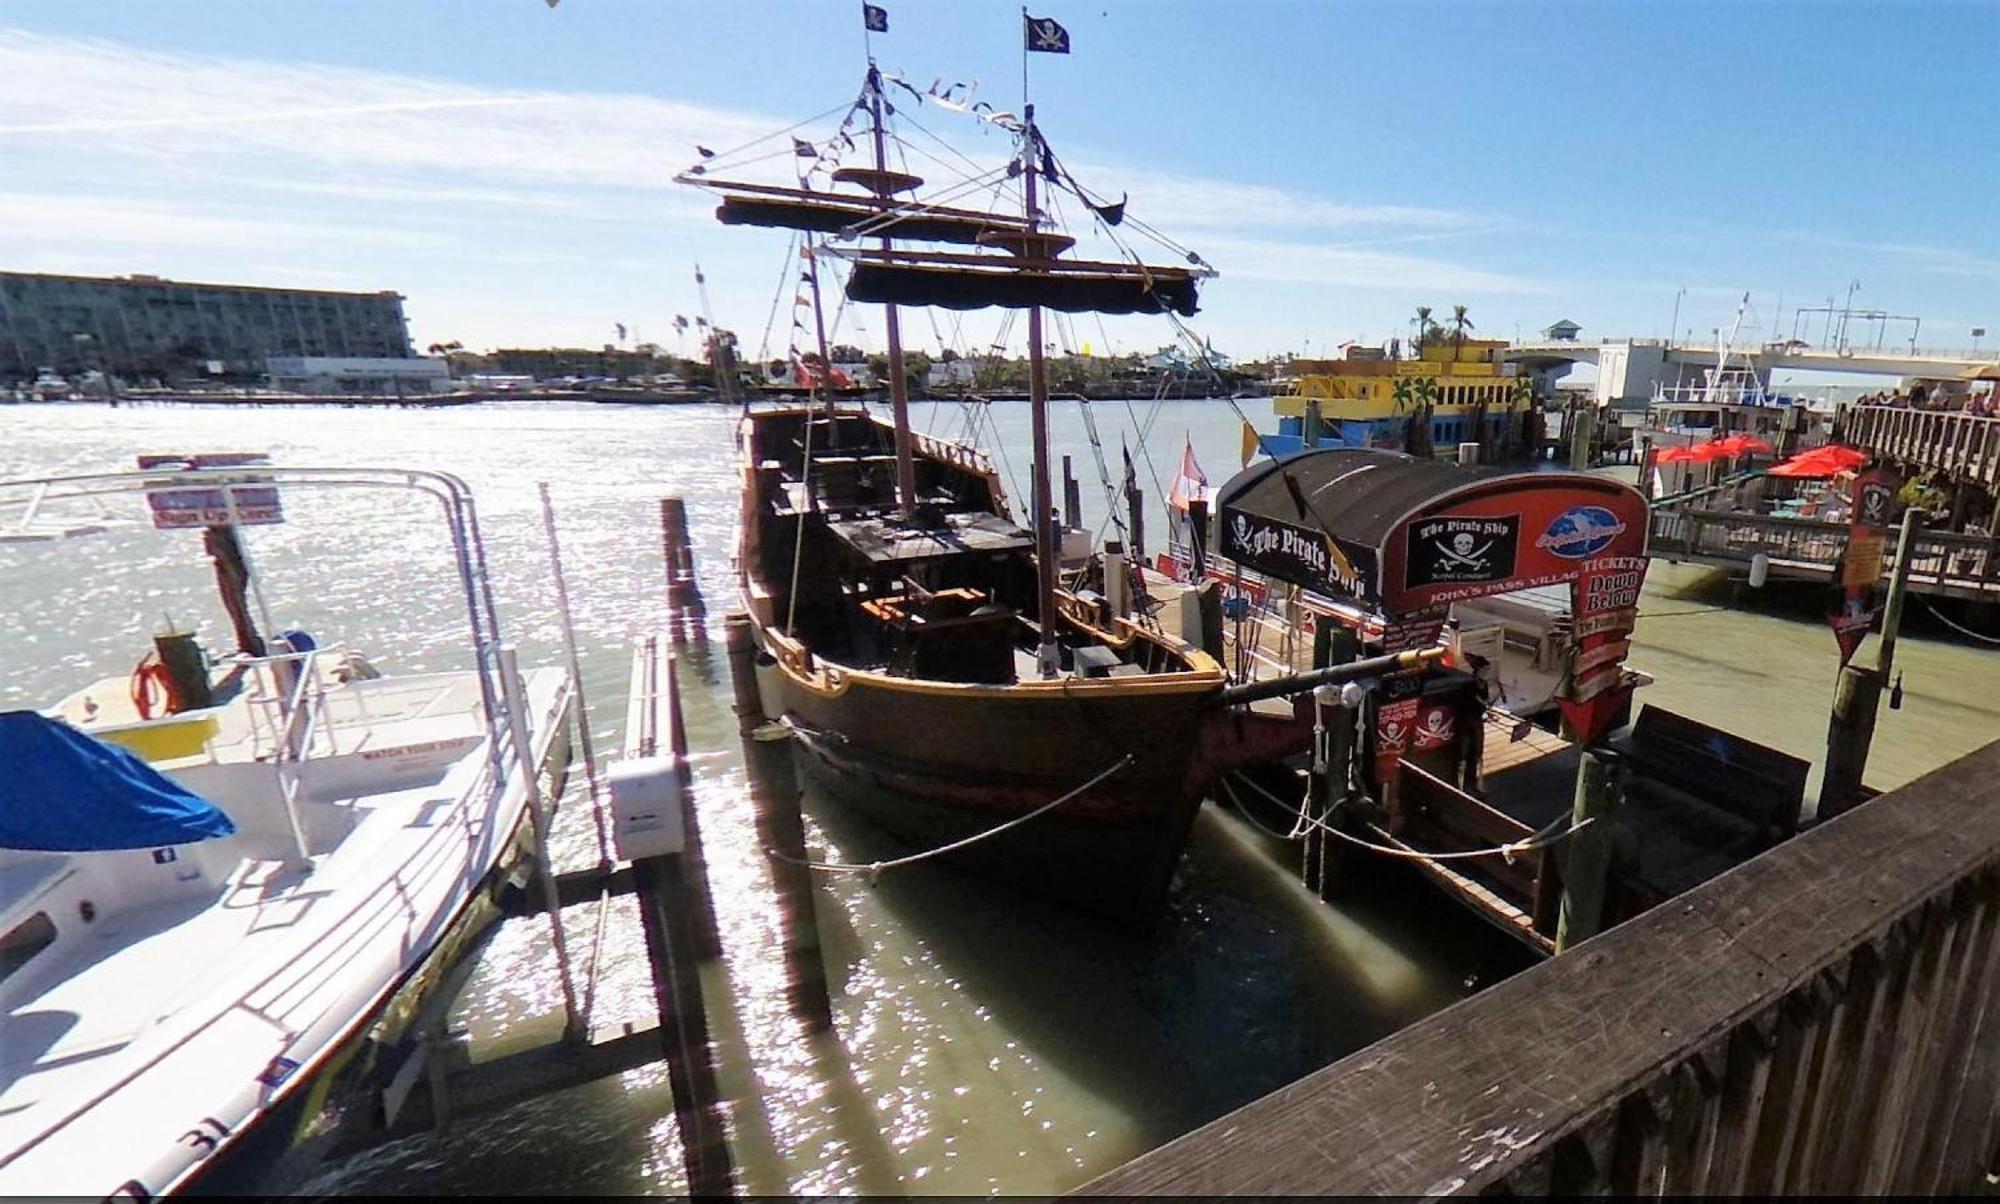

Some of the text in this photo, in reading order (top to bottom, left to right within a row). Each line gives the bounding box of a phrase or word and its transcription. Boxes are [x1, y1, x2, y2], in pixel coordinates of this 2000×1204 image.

[158, 511, 198, 524] Sign
[203, 507, 230, 522] Up
[1421, 521, 1509, 539] The Pirate Ship
[1254, 526, 1279, 556] The
[1281, 528, 1326, 571] Pirate
[1582, 556, 1648, 573] TICKETS
[1431, 570, 1579, 604] JOHN'S PASS VILLAG
[1589, 571, 1638, 593] Down
[1586, 589, 1637, 613] Below
